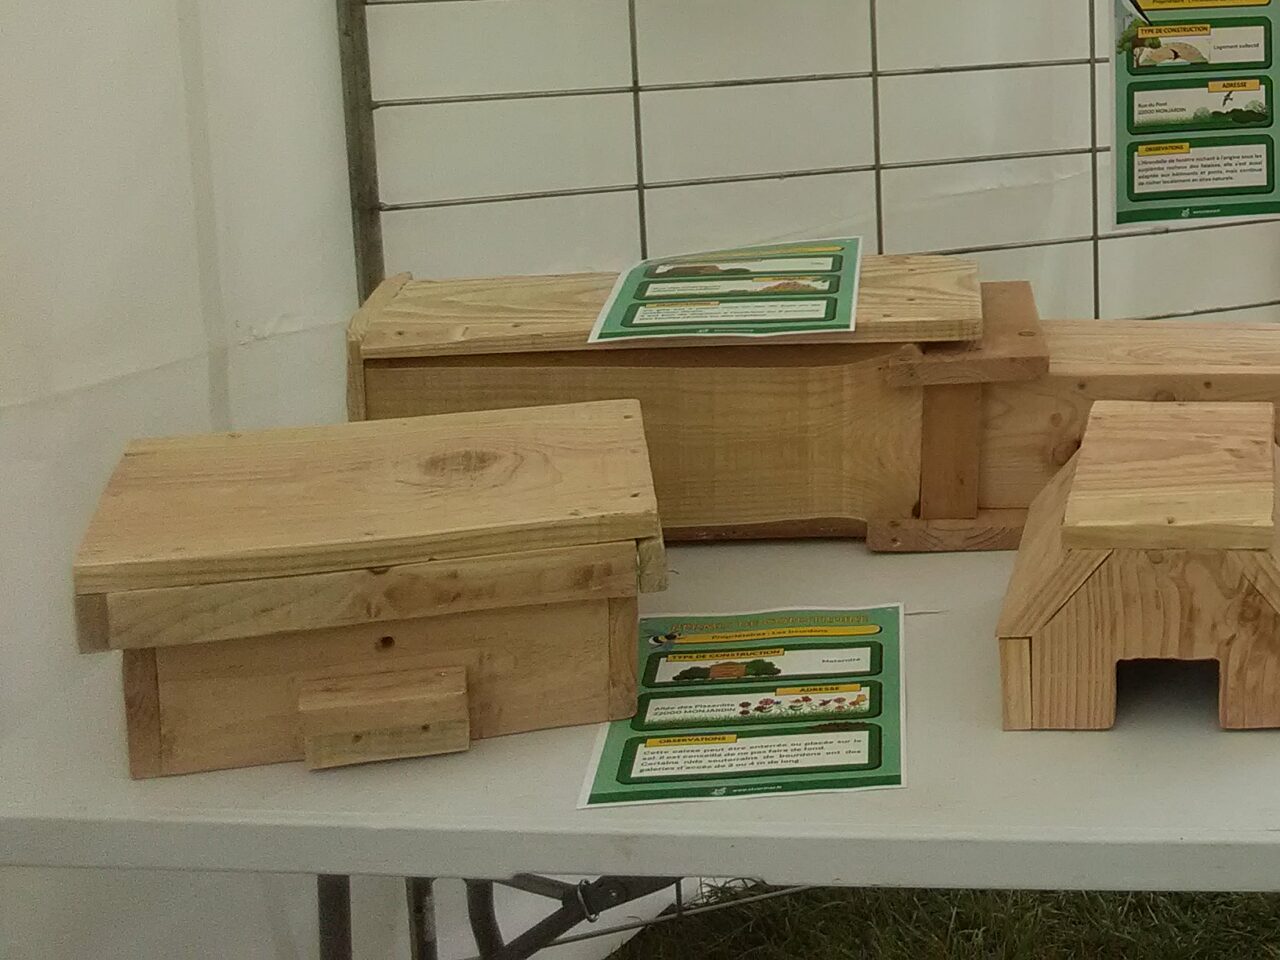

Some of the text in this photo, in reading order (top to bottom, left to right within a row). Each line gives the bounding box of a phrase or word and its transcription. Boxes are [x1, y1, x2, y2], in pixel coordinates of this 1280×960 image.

[1163, 25, 1208, 33] CONSTRUCTION
[1221, 80, 1247, 89] ADRESSE
[708, 649, 780, 657] CONSTRUCTION
[657, 735, 726, 744] OBSERVATIONS
